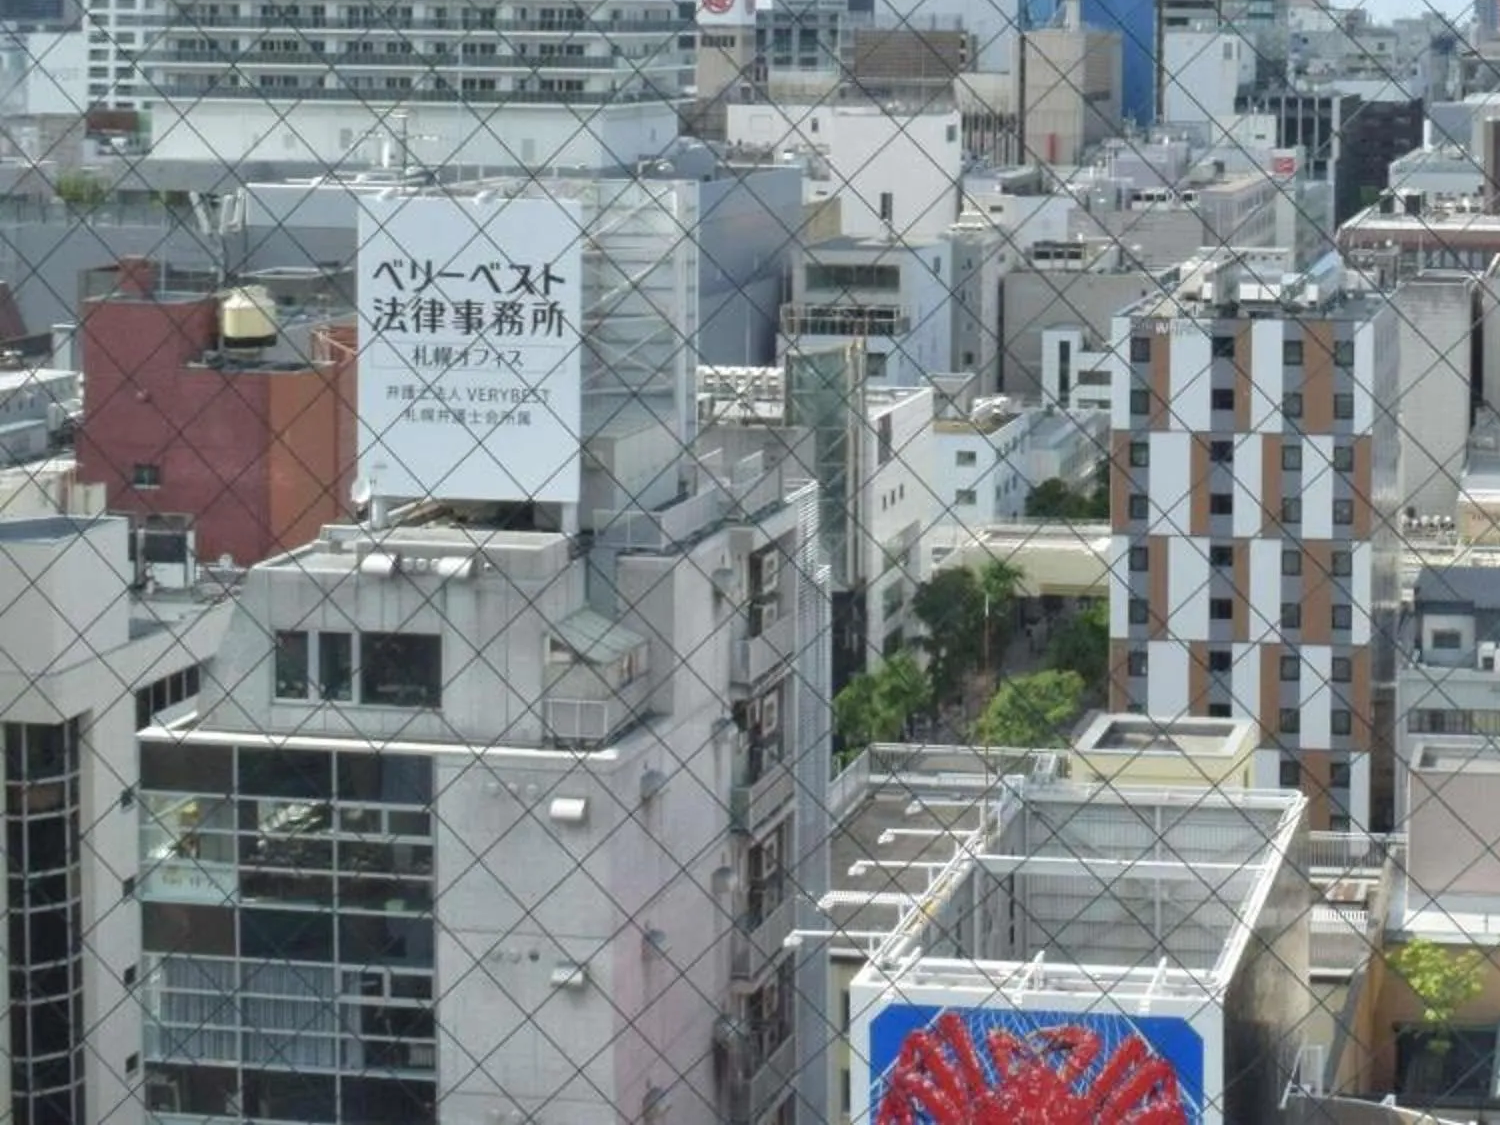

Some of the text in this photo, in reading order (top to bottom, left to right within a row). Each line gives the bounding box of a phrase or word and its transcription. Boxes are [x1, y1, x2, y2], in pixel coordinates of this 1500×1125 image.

[373, 260, 565, 296] ベリーベスト
[372, 297, 565, 338] 法律事務所
[412, 345, 524, 368] 札幌オフィス
